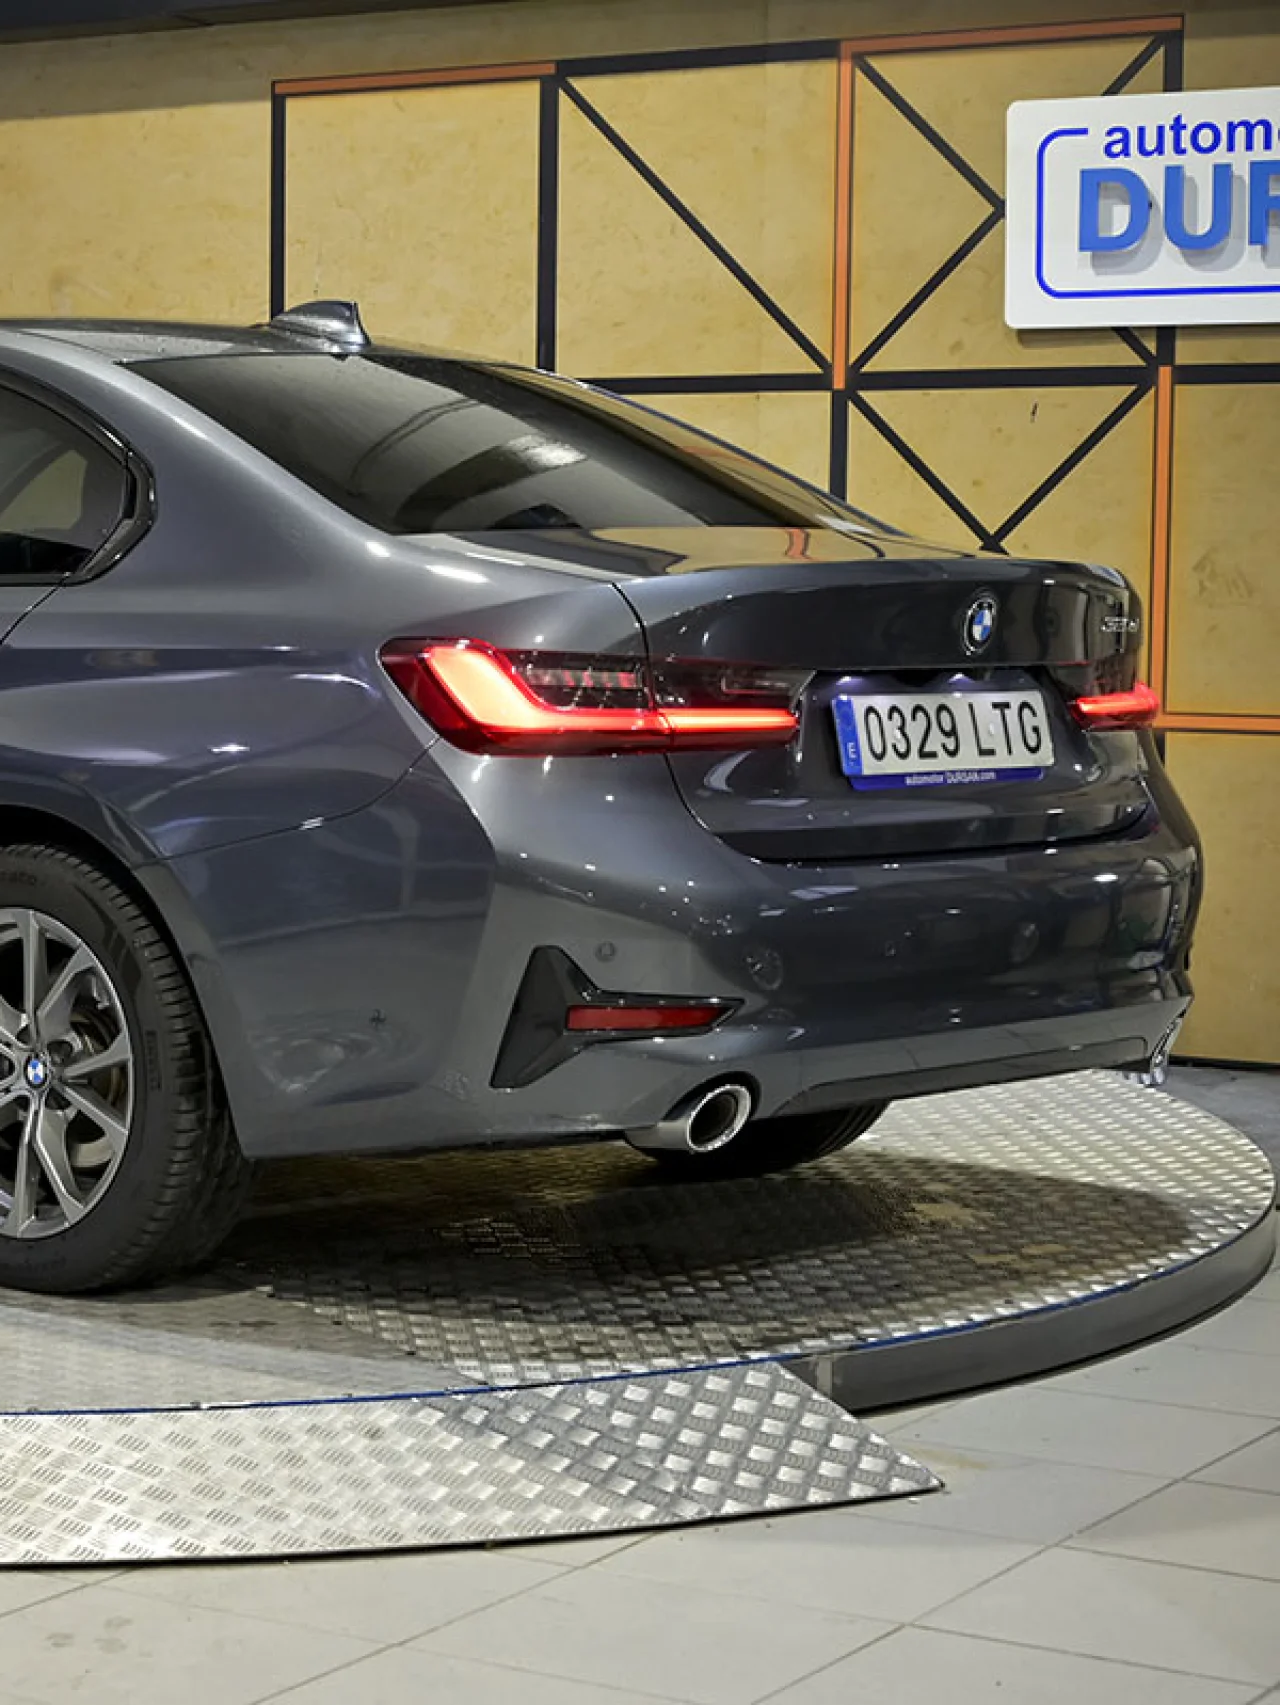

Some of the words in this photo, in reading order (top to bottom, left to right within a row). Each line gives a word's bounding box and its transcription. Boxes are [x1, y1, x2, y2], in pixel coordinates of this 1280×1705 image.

[1103, 113, 1280, 159] autom
[847, 742, 857, 759] E
[864, 703, 961, 762] 0329
[967, 701, 1042, 757] LTG
